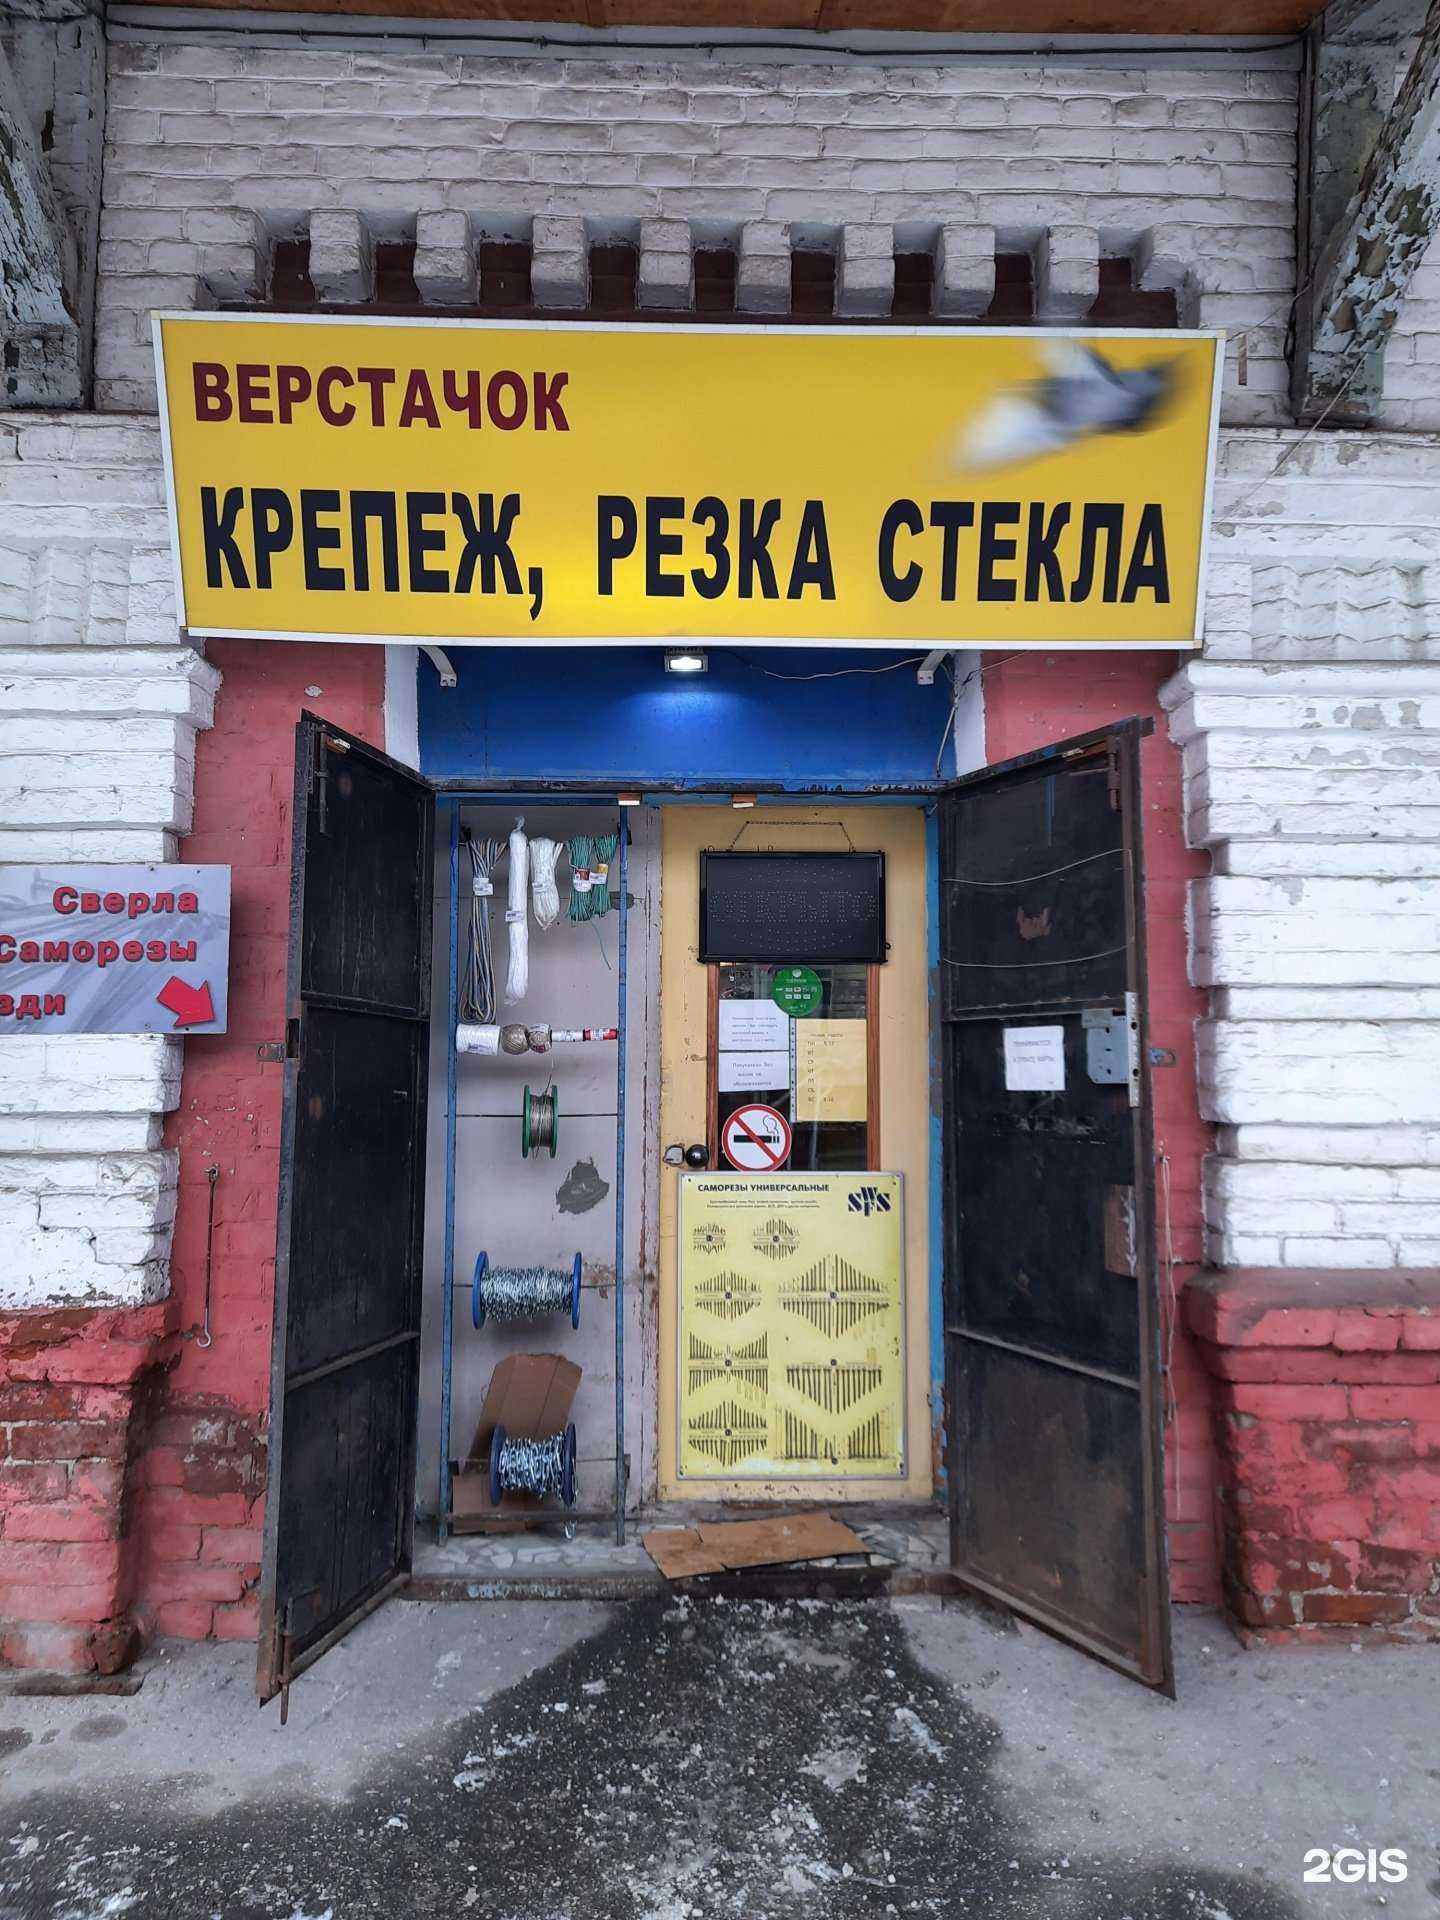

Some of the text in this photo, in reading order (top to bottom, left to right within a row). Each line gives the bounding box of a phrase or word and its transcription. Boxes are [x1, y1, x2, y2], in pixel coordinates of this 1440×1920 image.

[192, 361, 571, 432] ВЕРСТАЧОК
[200, 486, 1171, 622] КРЕПЕЖ, РЕЗКА СТЕКЛА
[53, 886, 199, 919] Сверла
[0, 934, 198, 968] Саморезы
[697, 1184, 830, 1193] САМОРЕЗЫ УНИВЕРСАЛЬНЫЕ
